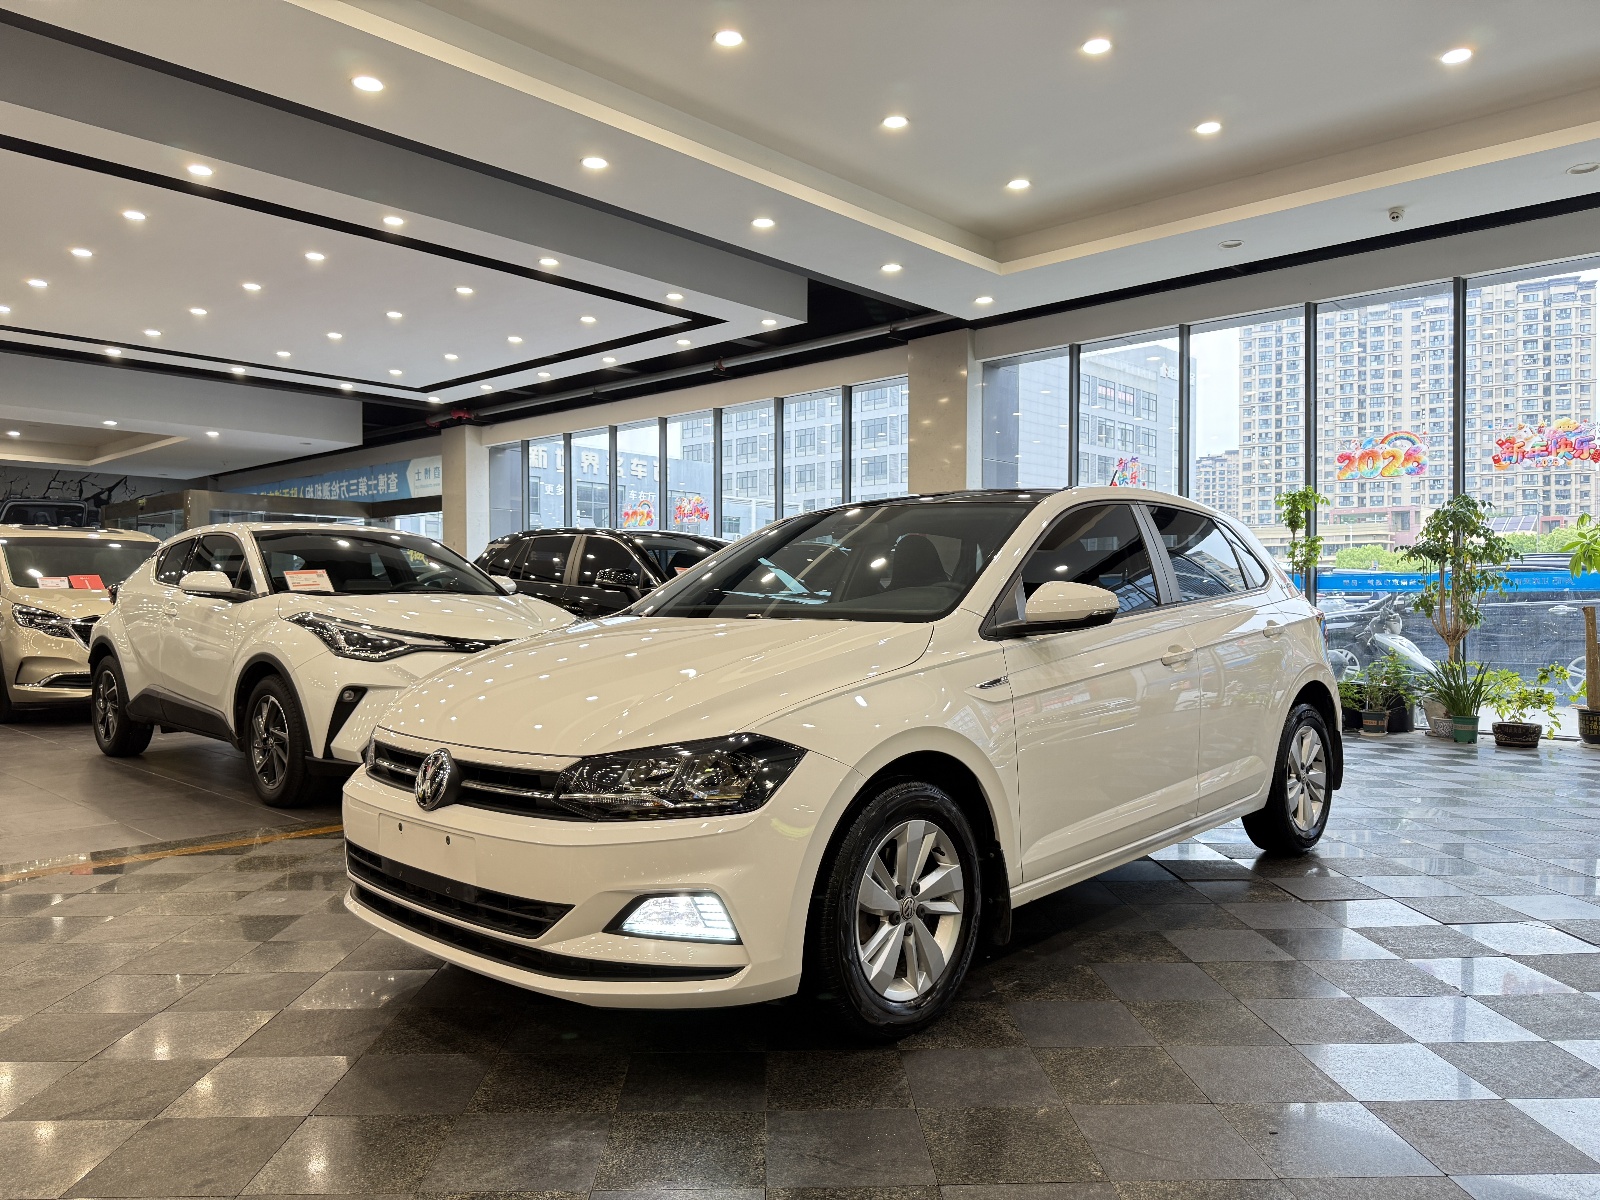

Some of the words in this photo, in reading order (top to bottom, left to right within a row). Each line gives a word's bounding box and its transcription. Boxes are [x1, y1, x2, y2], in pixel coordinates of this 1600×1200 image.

[1336, 443, 1429, 481] 2026
[1500, 434, 1595, 464] 新年快乐
